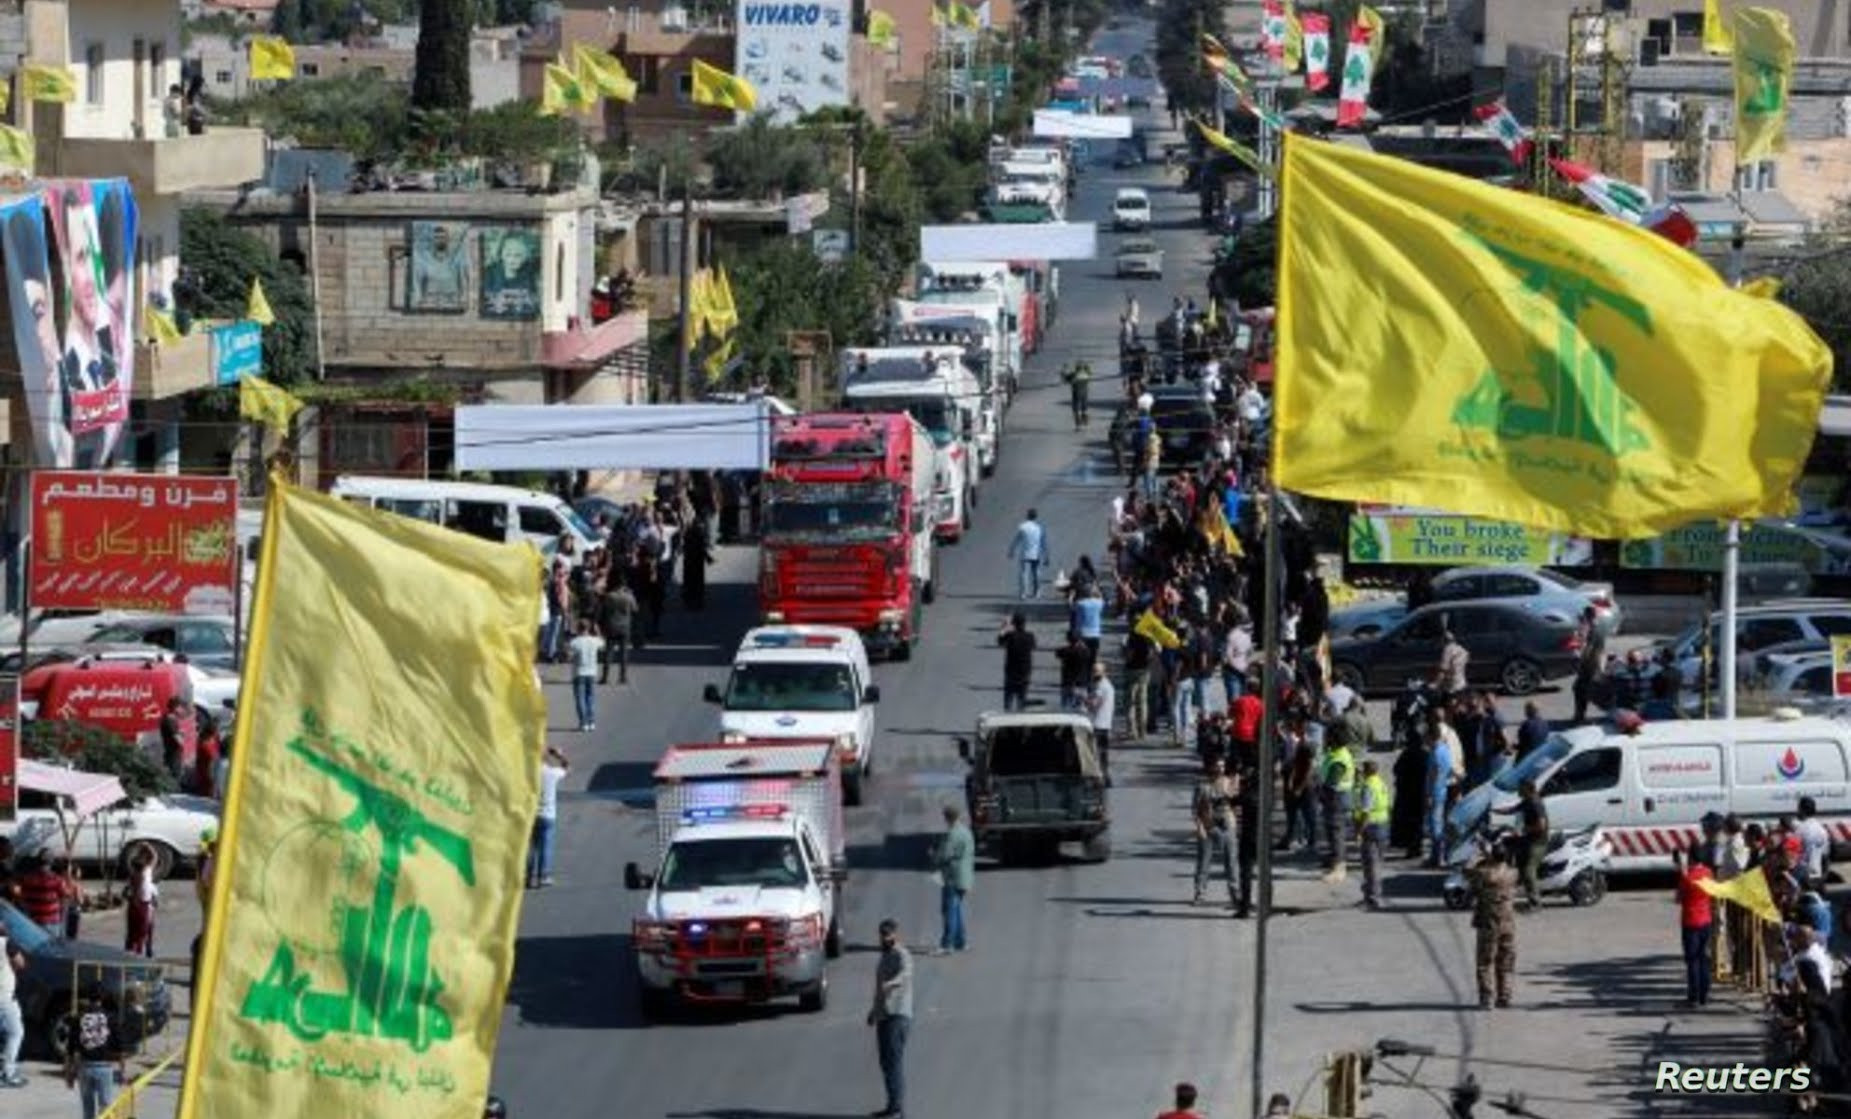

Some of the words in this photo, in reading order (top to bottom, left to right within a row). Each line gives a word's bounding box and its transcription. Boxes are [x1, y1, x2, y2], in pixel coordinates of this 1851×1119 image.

[745, 4, 820, 25] VIVARO
[42, 477, 156, 507] ومطعم
[165, 482, 227, 509] فرن
[74, 516, 183, 566] البركان
[1416, 519, 1454, 538] You
[1464, 519, 1524, 539] broke
[1410, 538, 1468, 557] Their
[1478, 541, 1530, 562] siege
